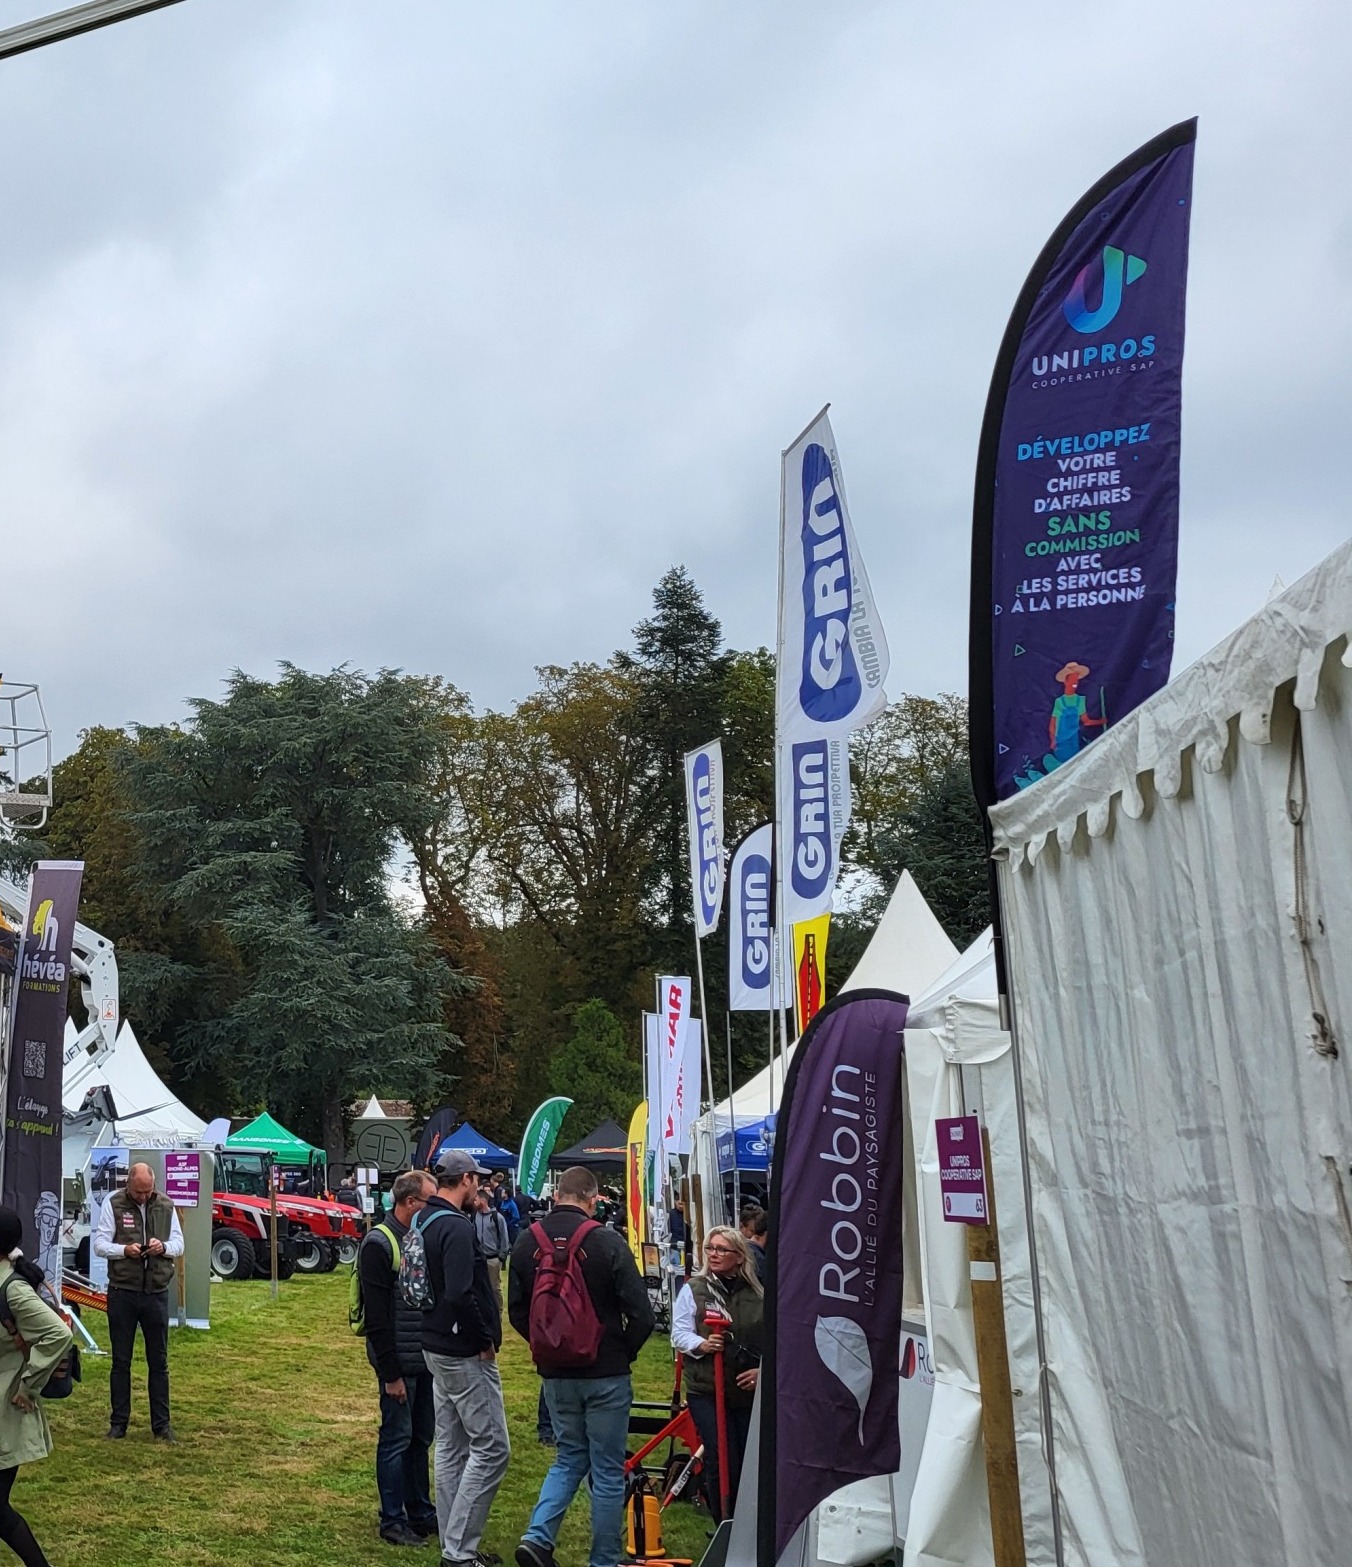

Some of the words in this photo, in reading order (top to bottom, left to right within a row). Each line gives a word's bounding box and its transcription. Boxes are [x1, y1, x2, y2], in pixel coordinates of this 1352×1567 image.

[1032, 335, 1156, 376] UNIPROS
[1032, 366, 1122, 389] COOPERATIVE
[1129, 361, 1155, 372] SAP
[1017, 422, 1151, 461] DÉVELOPPEZ
[1057, 452, 1117, 473] VOTRE
[1047, 470, 1121, 493] CHIFFRE
[1034, 487, 1132, 513] D'AFFAIRES
[1047, 510, 1112, 536] SANS
[1024, 528, 1140, 557] COMMISSION
[1056, 553, 1102, 572] AVEC
[809, 476, 849, 690] GRIN
[1022, 577, 1052, 594] LES
[1056, 567, 1142, 591] SERVICES
[1010, 594, 1025, 613] À
[1029, 597, 1051, 612] LA
[1056, 584, 1146, 609] PERSONNE
[852, 621, 881, 690] CAMBIA
[798, 752, 827, 880] GRIN
[698, 774, 718, 907] GRIN
[745, 872, 769, 974] GRIN
[22, 953, 65, 981] hévéa
[864, 1071, 877, 1191] PAYSAGISTE
[818, 1062, 861, 1303] Robbin
[864, 1198, 878, 1227] DU
[976, 1198, 983, 1213] 63
[864, 1236, 877, 1308] L'ALLIÉ
